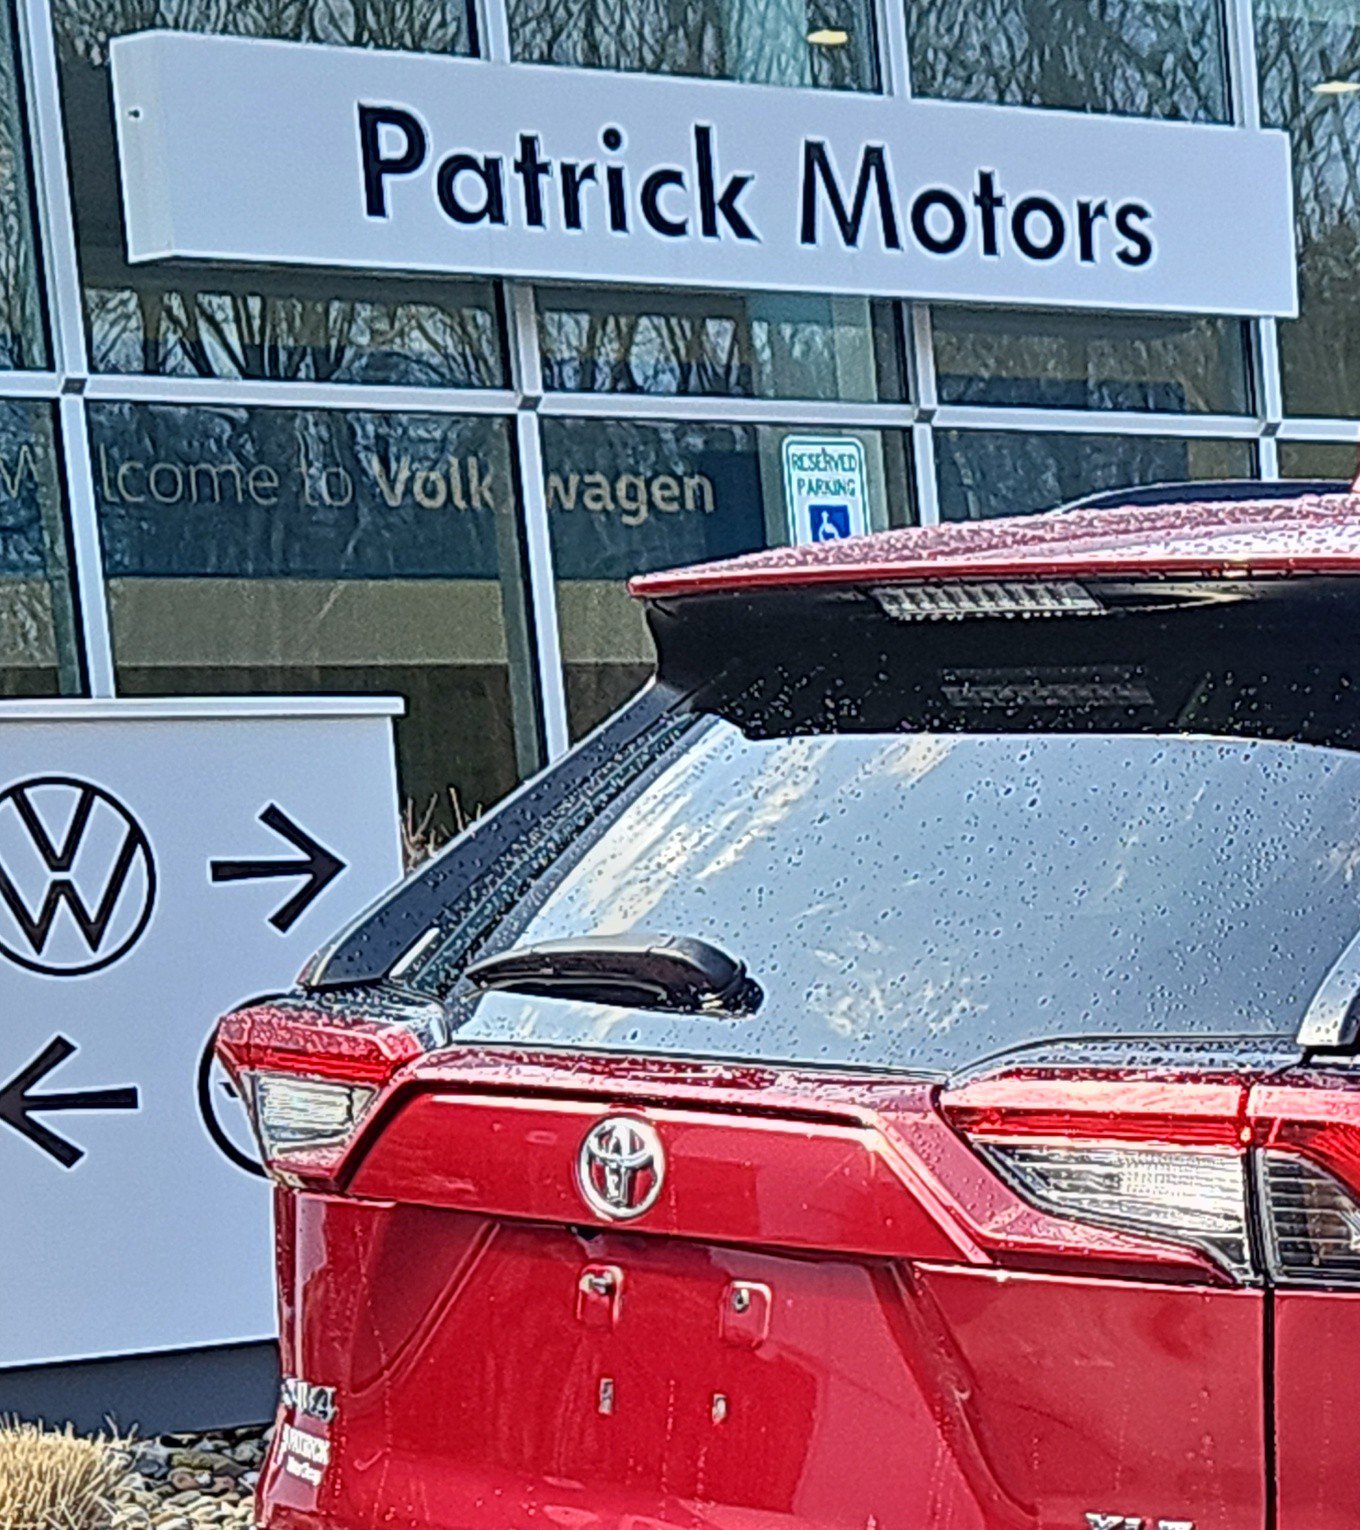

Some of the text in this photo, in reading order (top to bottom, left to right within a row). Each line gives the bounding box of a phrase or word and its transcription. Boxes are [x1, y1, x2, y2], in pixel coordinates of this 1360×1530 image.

[357, 100, 1154, 267] Patrick Motors
[0, 444, 715, 527] Wlcome to Volkwagen
[792, 452, 858, 470] RESERVED
[797, 477, 856, 497] PARKING
